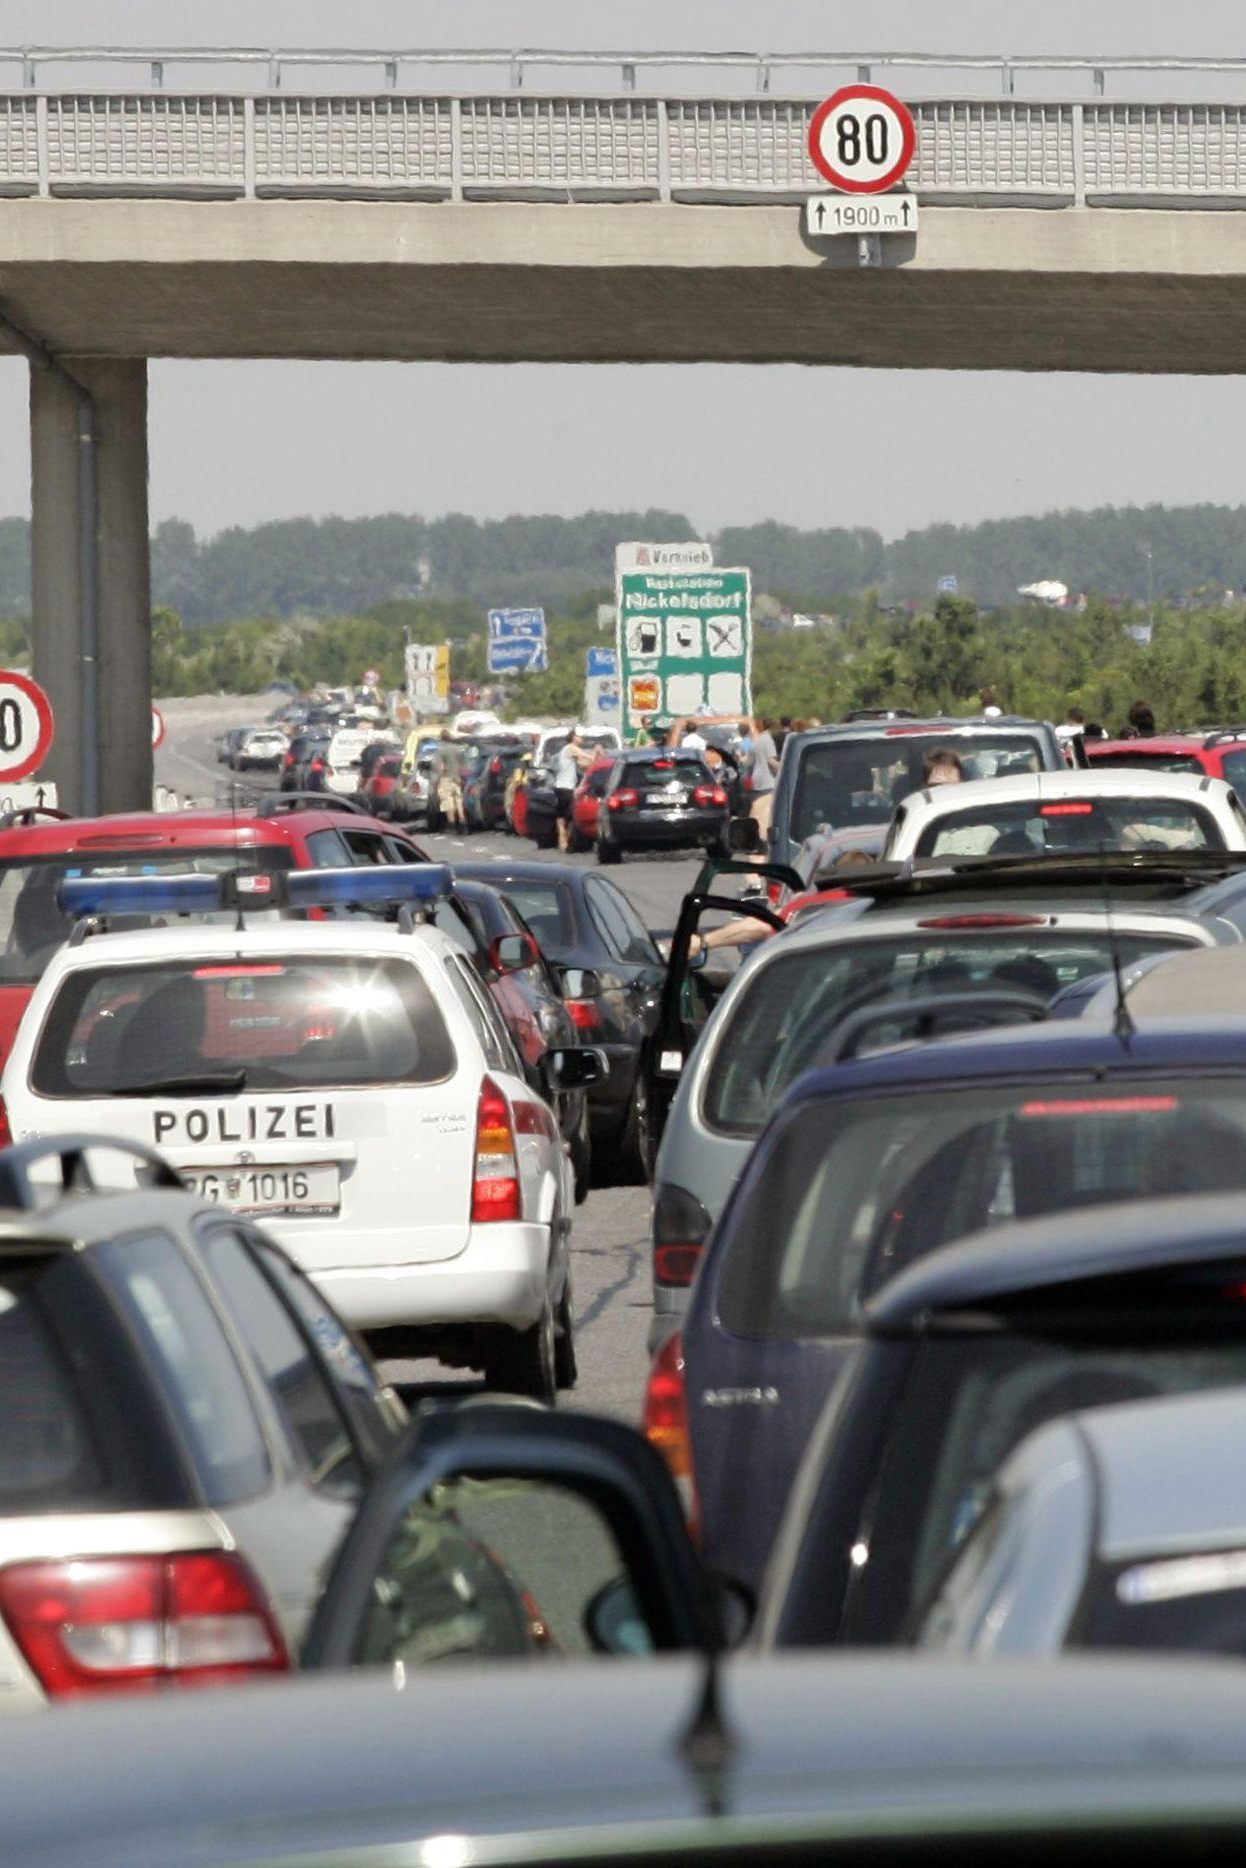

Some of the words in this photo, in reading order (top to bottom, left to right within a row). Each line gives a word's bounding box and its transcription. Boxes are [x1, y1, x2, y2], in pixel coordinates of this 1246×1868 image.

[837, 114, 889, 166] 80
[834, 206, 881, 226] 1900
[626, 592, 743, 609] Nickelsdorf
[154, 1104, 335, 1142] POLIZEI
[248, 1171, 309, 1202] 1016
